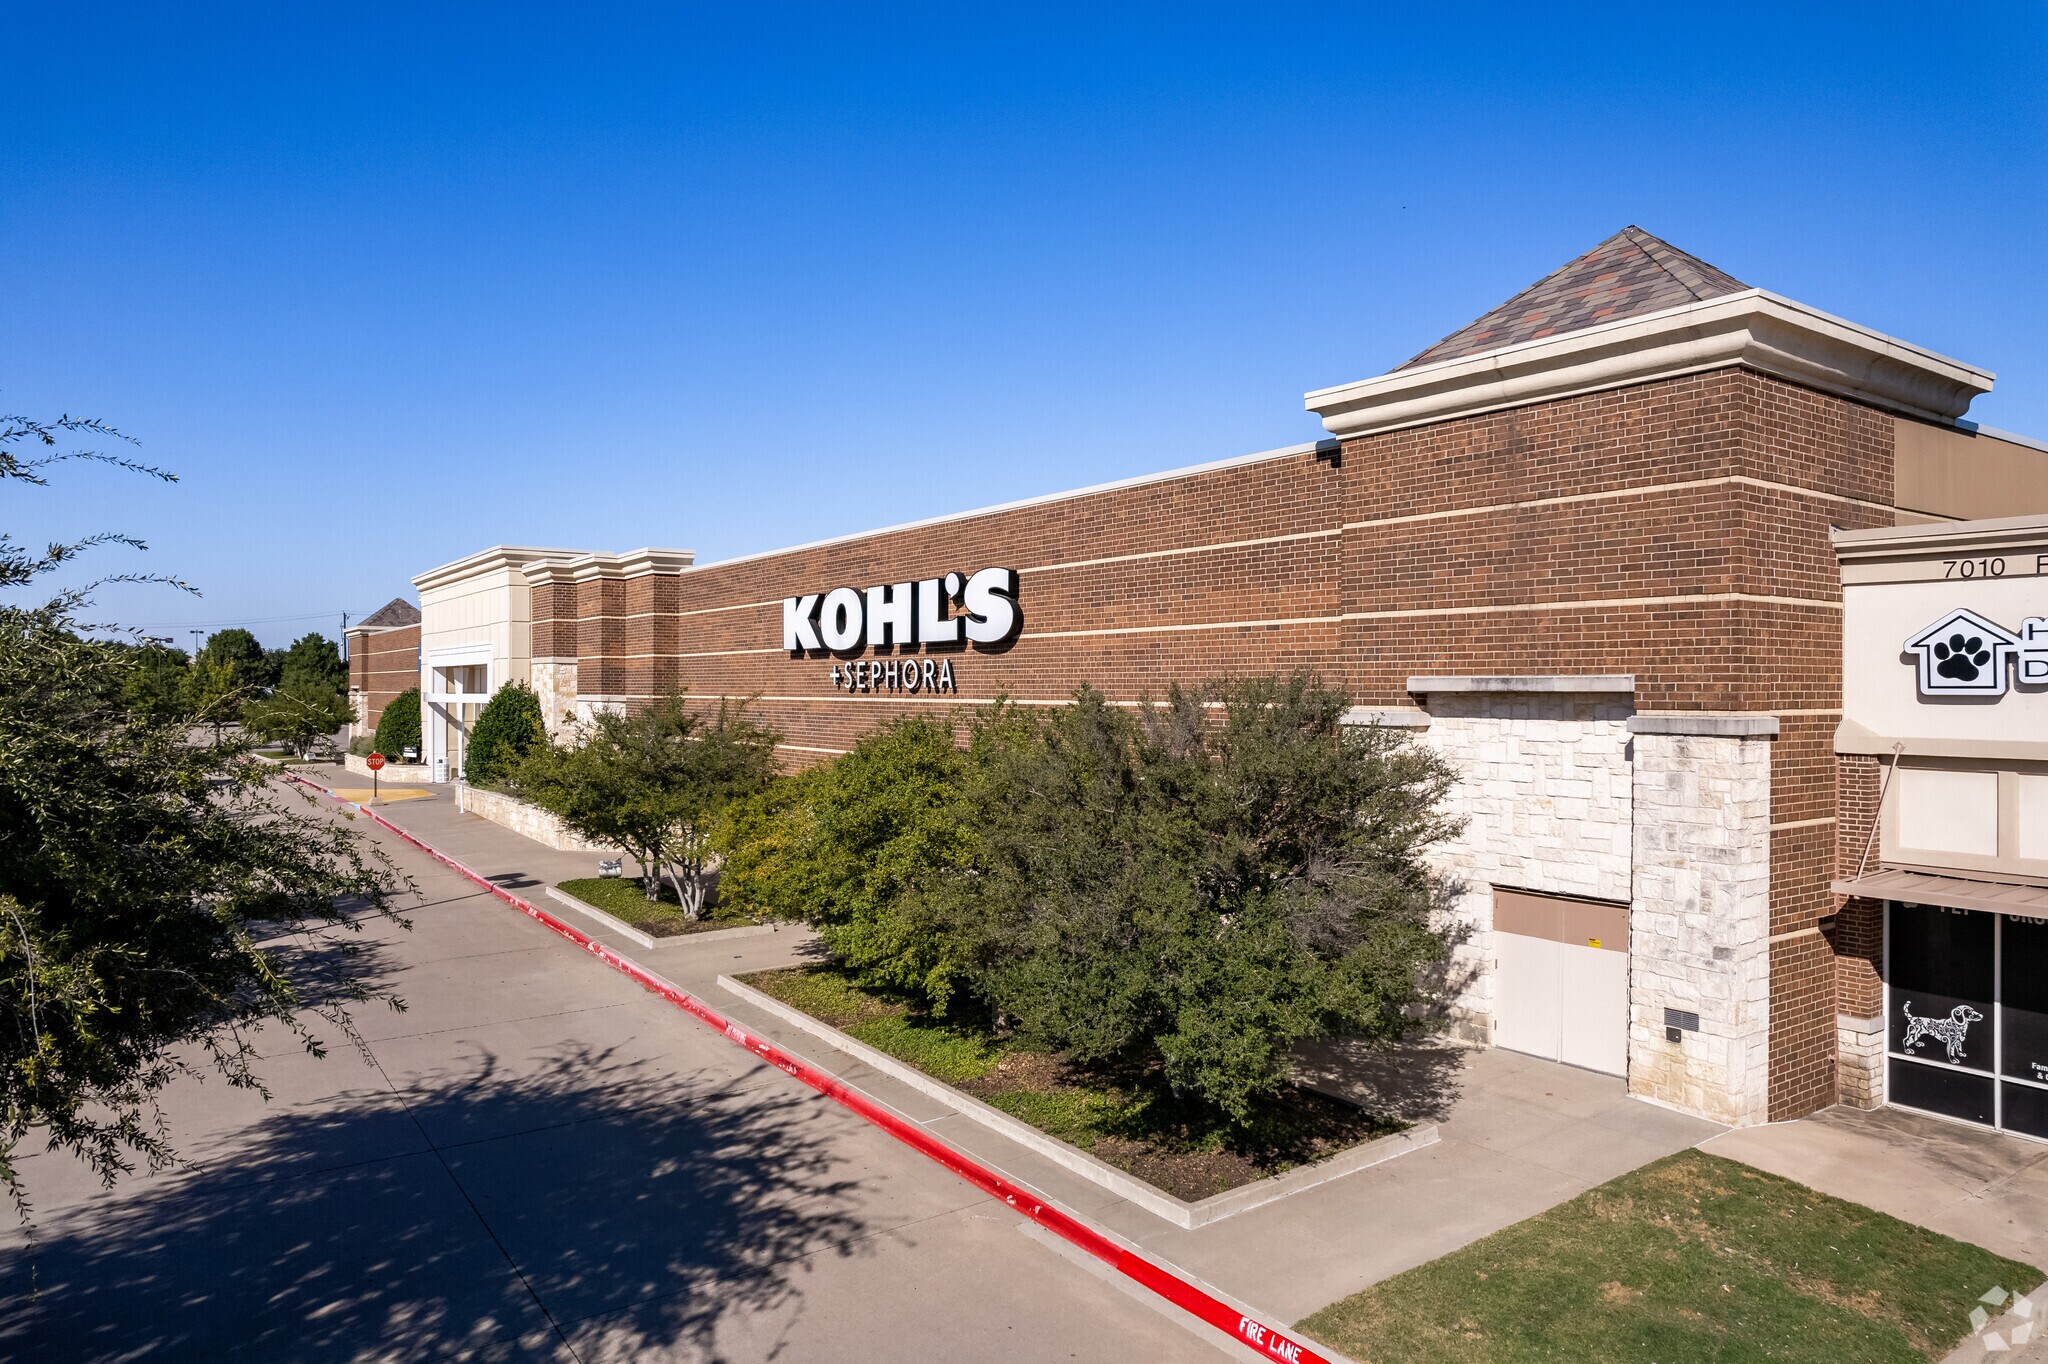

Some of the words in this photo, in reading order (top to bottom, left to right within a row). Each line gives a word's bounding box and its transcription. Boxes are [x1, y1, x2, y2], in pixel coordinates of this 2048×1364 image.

[1943, 558, 2005, 578] 7010
[783, 567, 1018, 651] KOHL'S
[1239, 1316, 1266, 1345] FIRE
[1269, 1334, 1302, 1364] LANE
